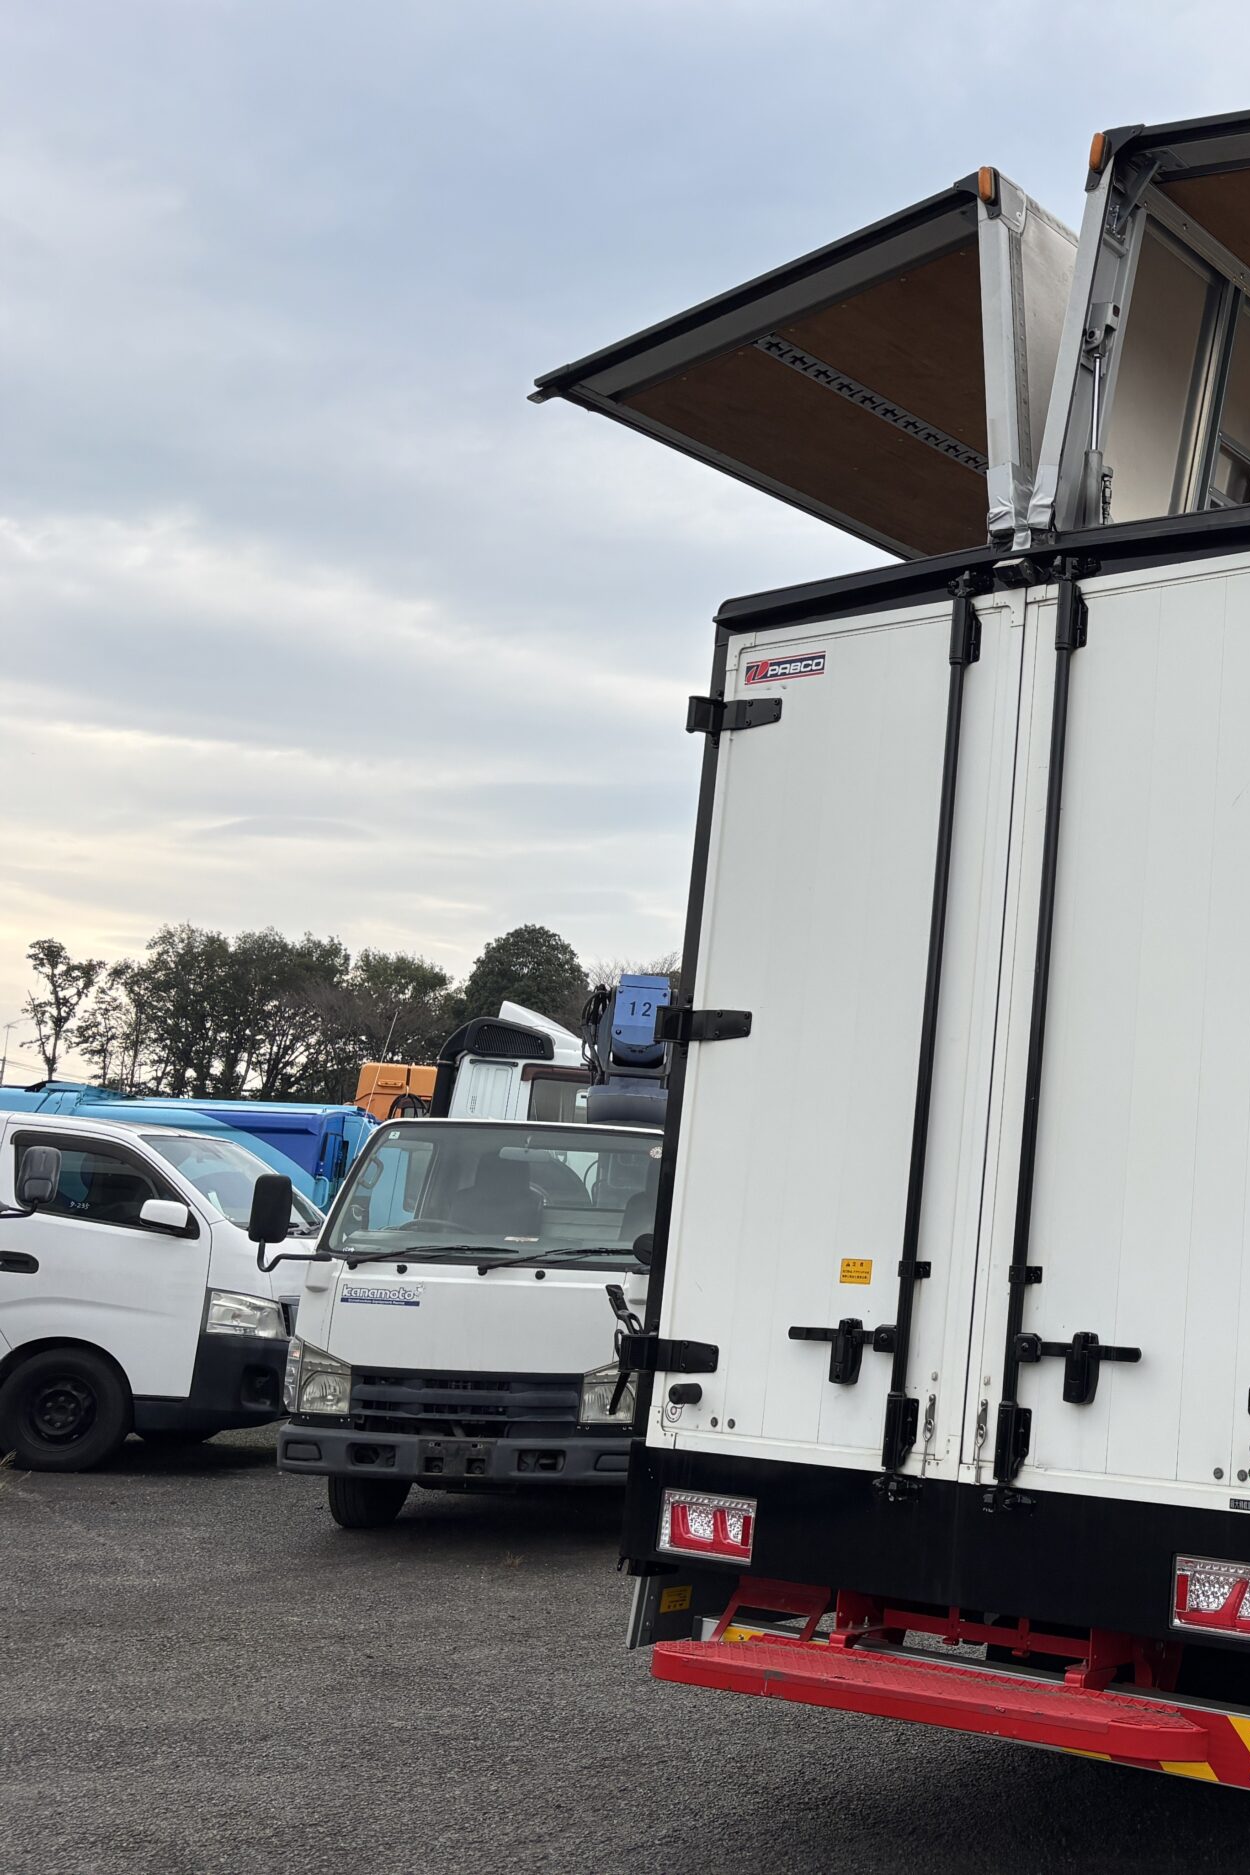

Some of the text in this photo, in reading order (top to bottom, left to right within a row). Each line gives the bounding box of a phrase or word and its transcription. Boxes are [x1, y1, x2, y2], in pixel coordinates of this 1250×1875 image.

[767, 658, 824, 677] PABCO
[629, 1001, 652, 1017] 12
[342, 1284, 414, 1299] kanamoto
